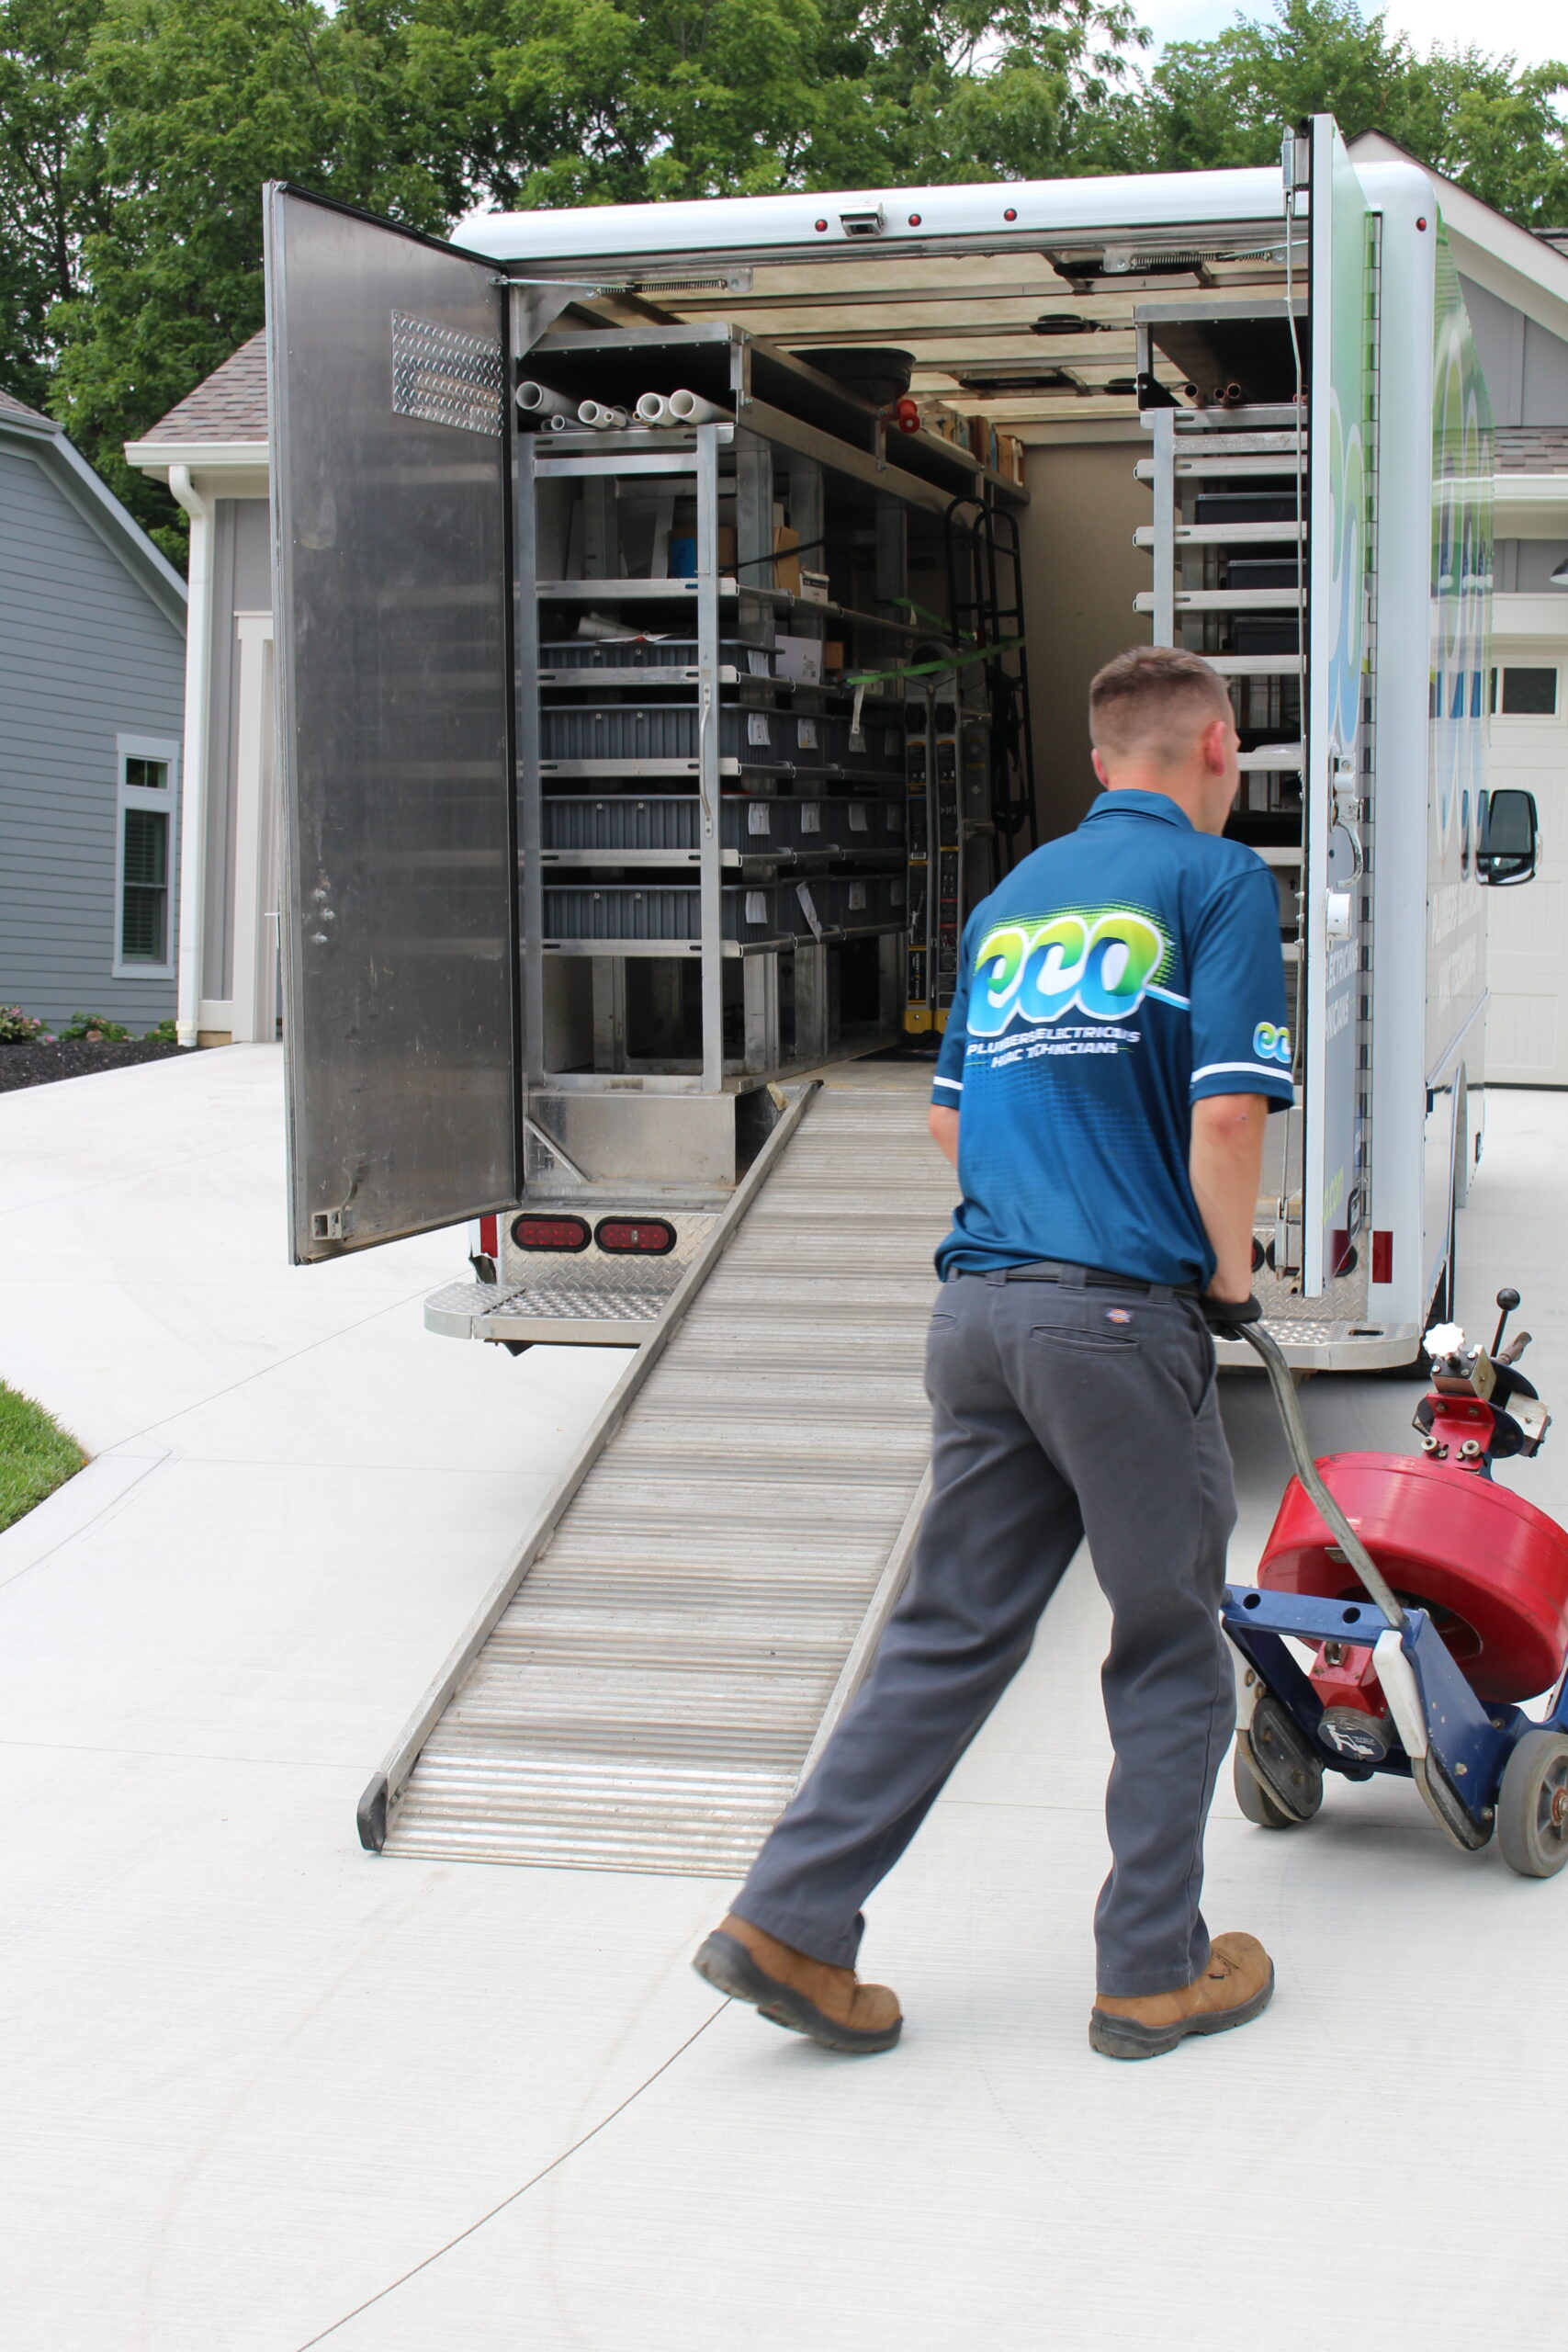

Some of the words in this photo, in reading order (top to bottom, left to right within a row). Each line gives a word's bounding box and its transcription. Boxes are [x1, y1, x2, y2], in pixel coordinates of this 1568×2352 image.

[966, 912, 1165, 1037] eco
[1034, 1026, 1141, 1043] ELECTRICIS
[1252, 1021, 1292, 1064] ec
[1025, 1042, 1118, 1058] TCHNICIANS
